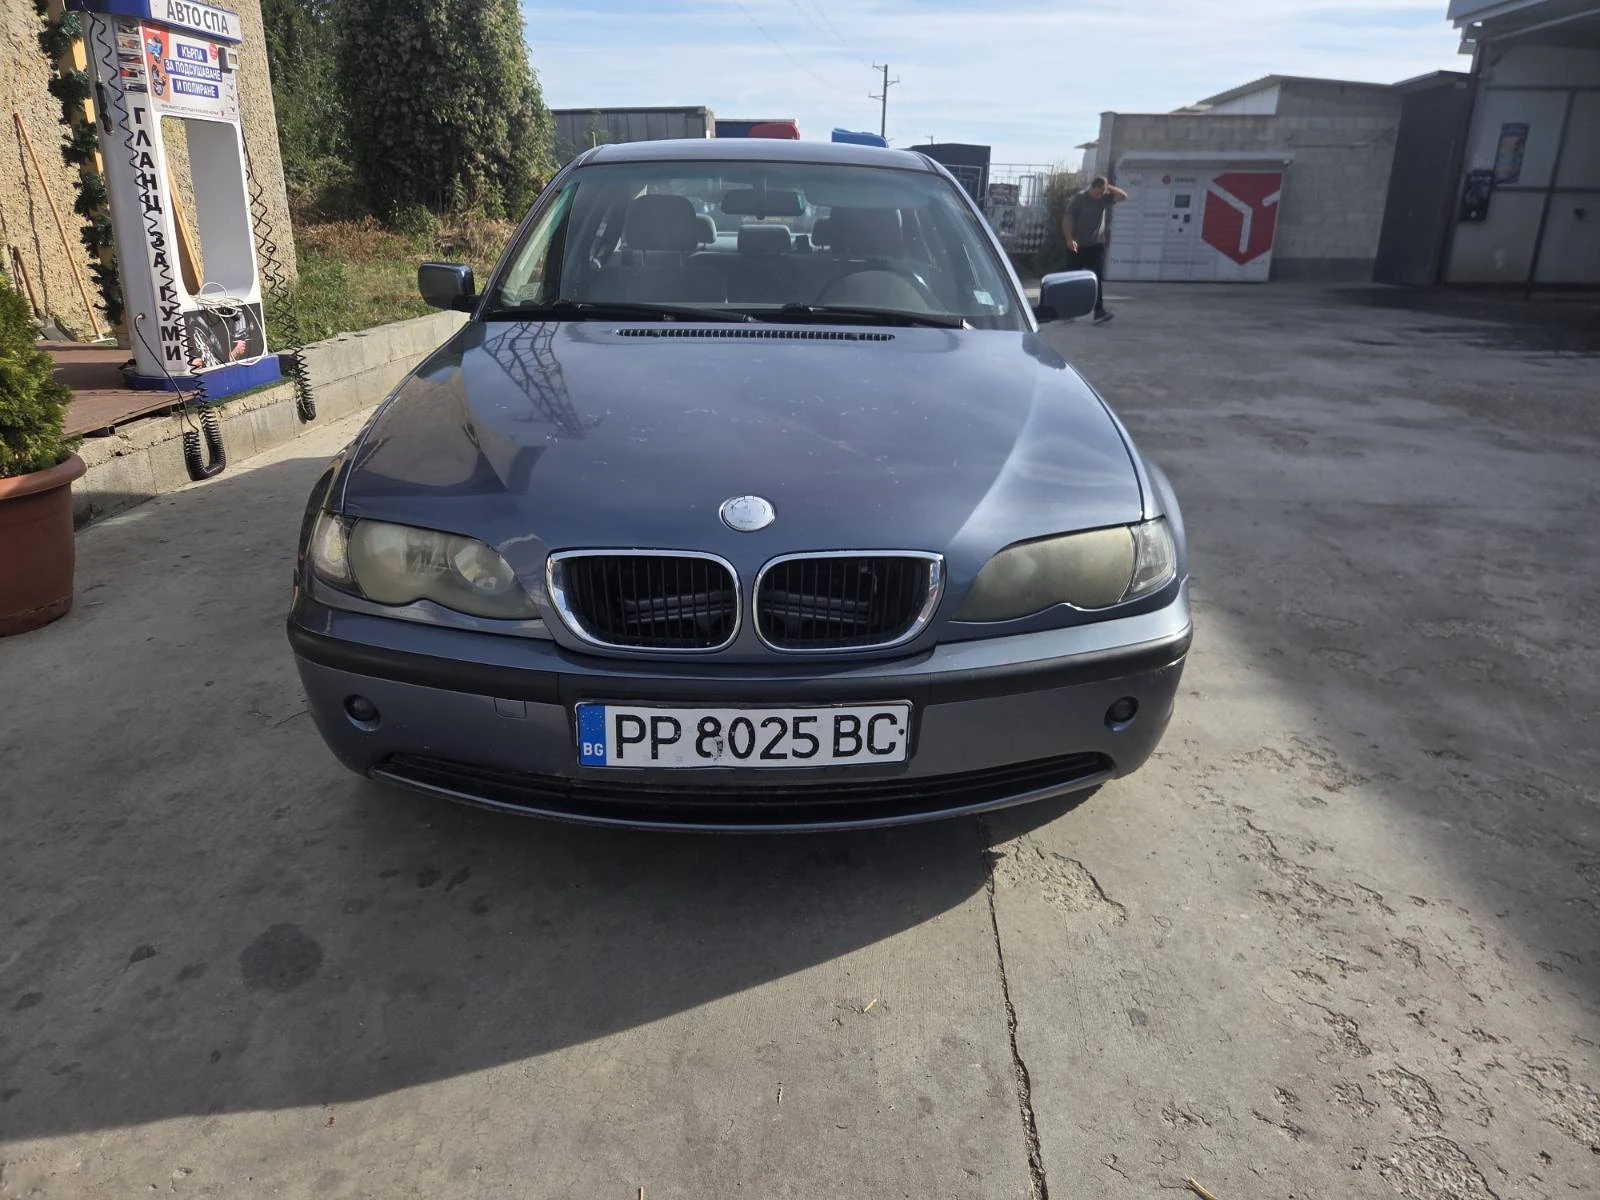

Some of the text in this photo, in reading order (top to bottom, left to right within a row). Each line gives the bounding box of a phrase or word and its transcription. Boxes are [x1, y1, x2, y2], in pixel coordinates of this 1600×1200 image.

[167, 1, 229, 34] АВТО СПА
[181, 46, 204, 61] КЪРПА
[165, 60, 222, 81] ЗА ПОДСУШАВАНЕ
[176, 80, 216, 97] И ПОЛИРАНЕ
[133, 107, 182, 361] ГЛАНЦ ЗА ГУМИ
[615, 713, 898, 761] PP 8025 BC
[583, 742, 604, 756] BG
